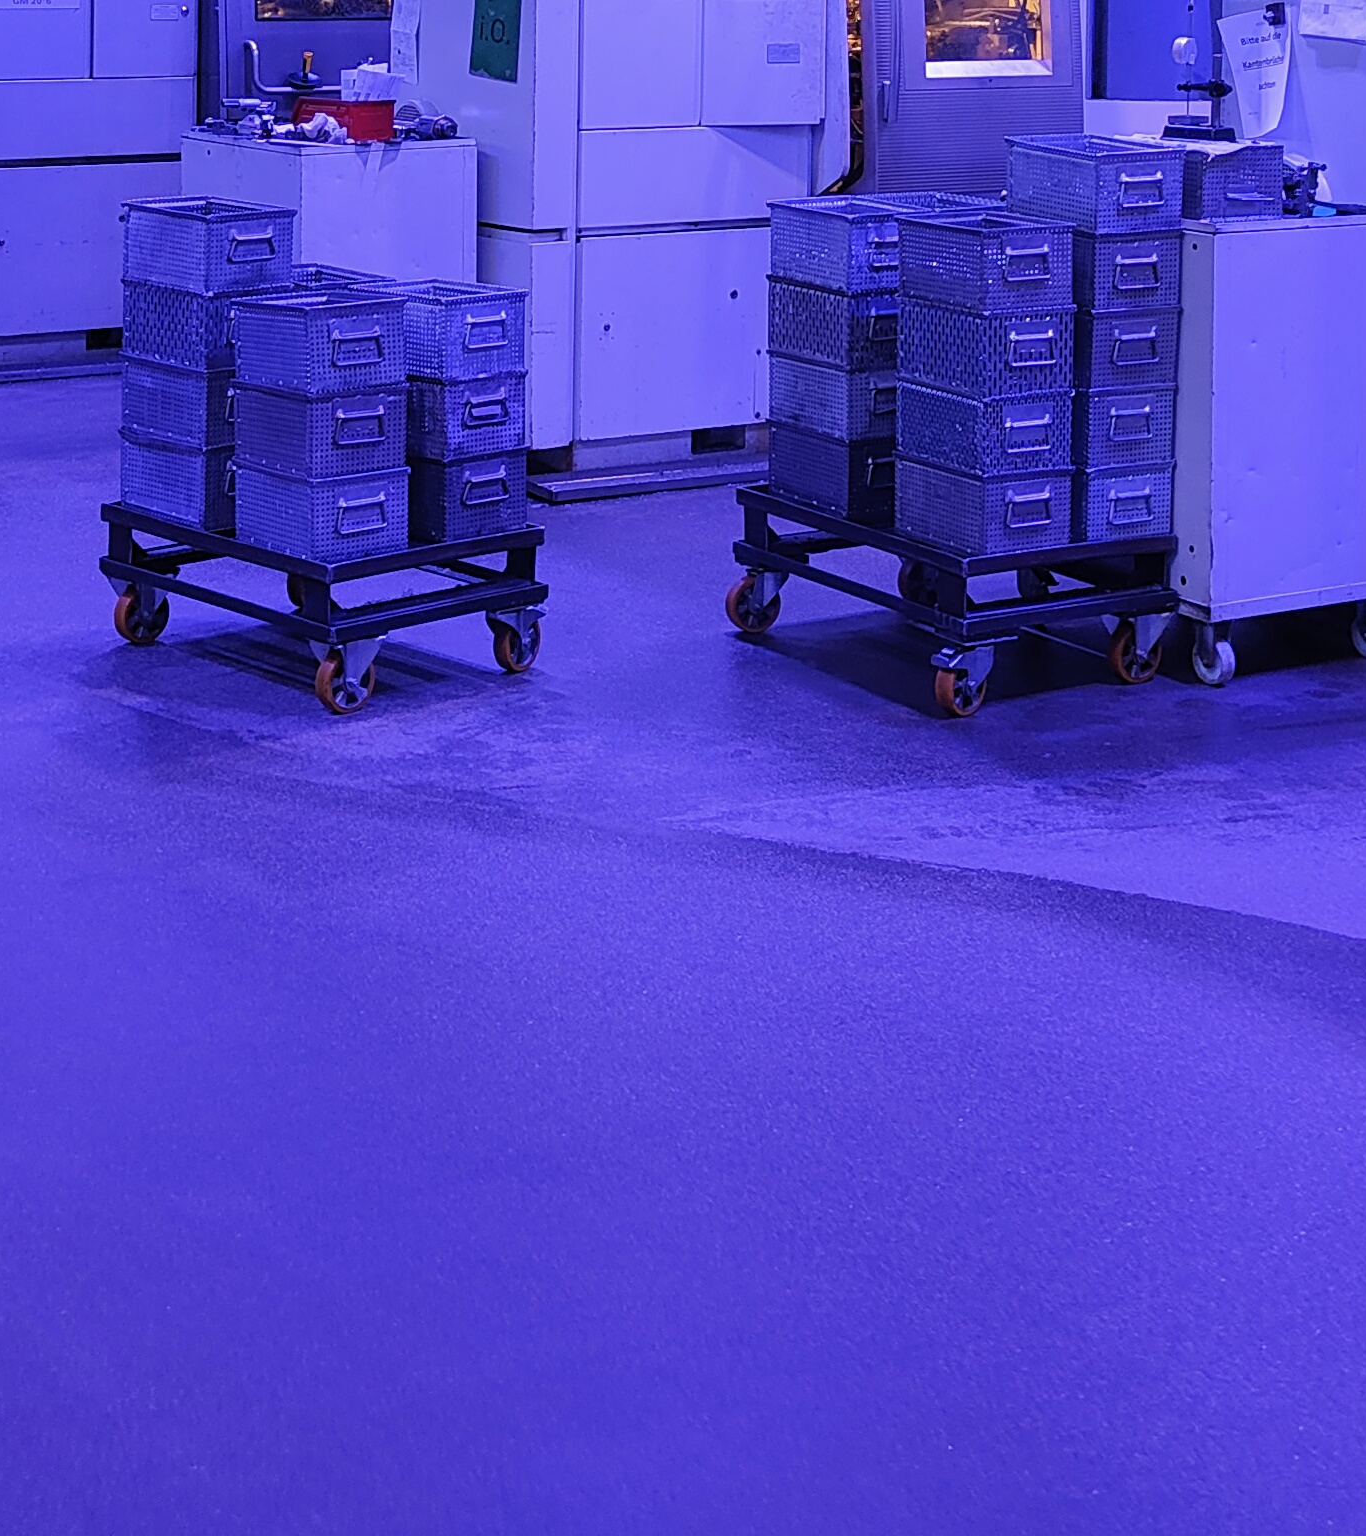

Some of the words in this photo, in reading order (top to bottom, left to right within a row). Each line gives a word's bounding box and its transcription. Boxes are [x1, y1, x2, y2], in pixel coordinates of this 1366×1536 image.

[479, 15, 511, 46] i.O.
[1240, 37, 1259, 46] Bitte
[1261, 33, 1271, 42] auf
